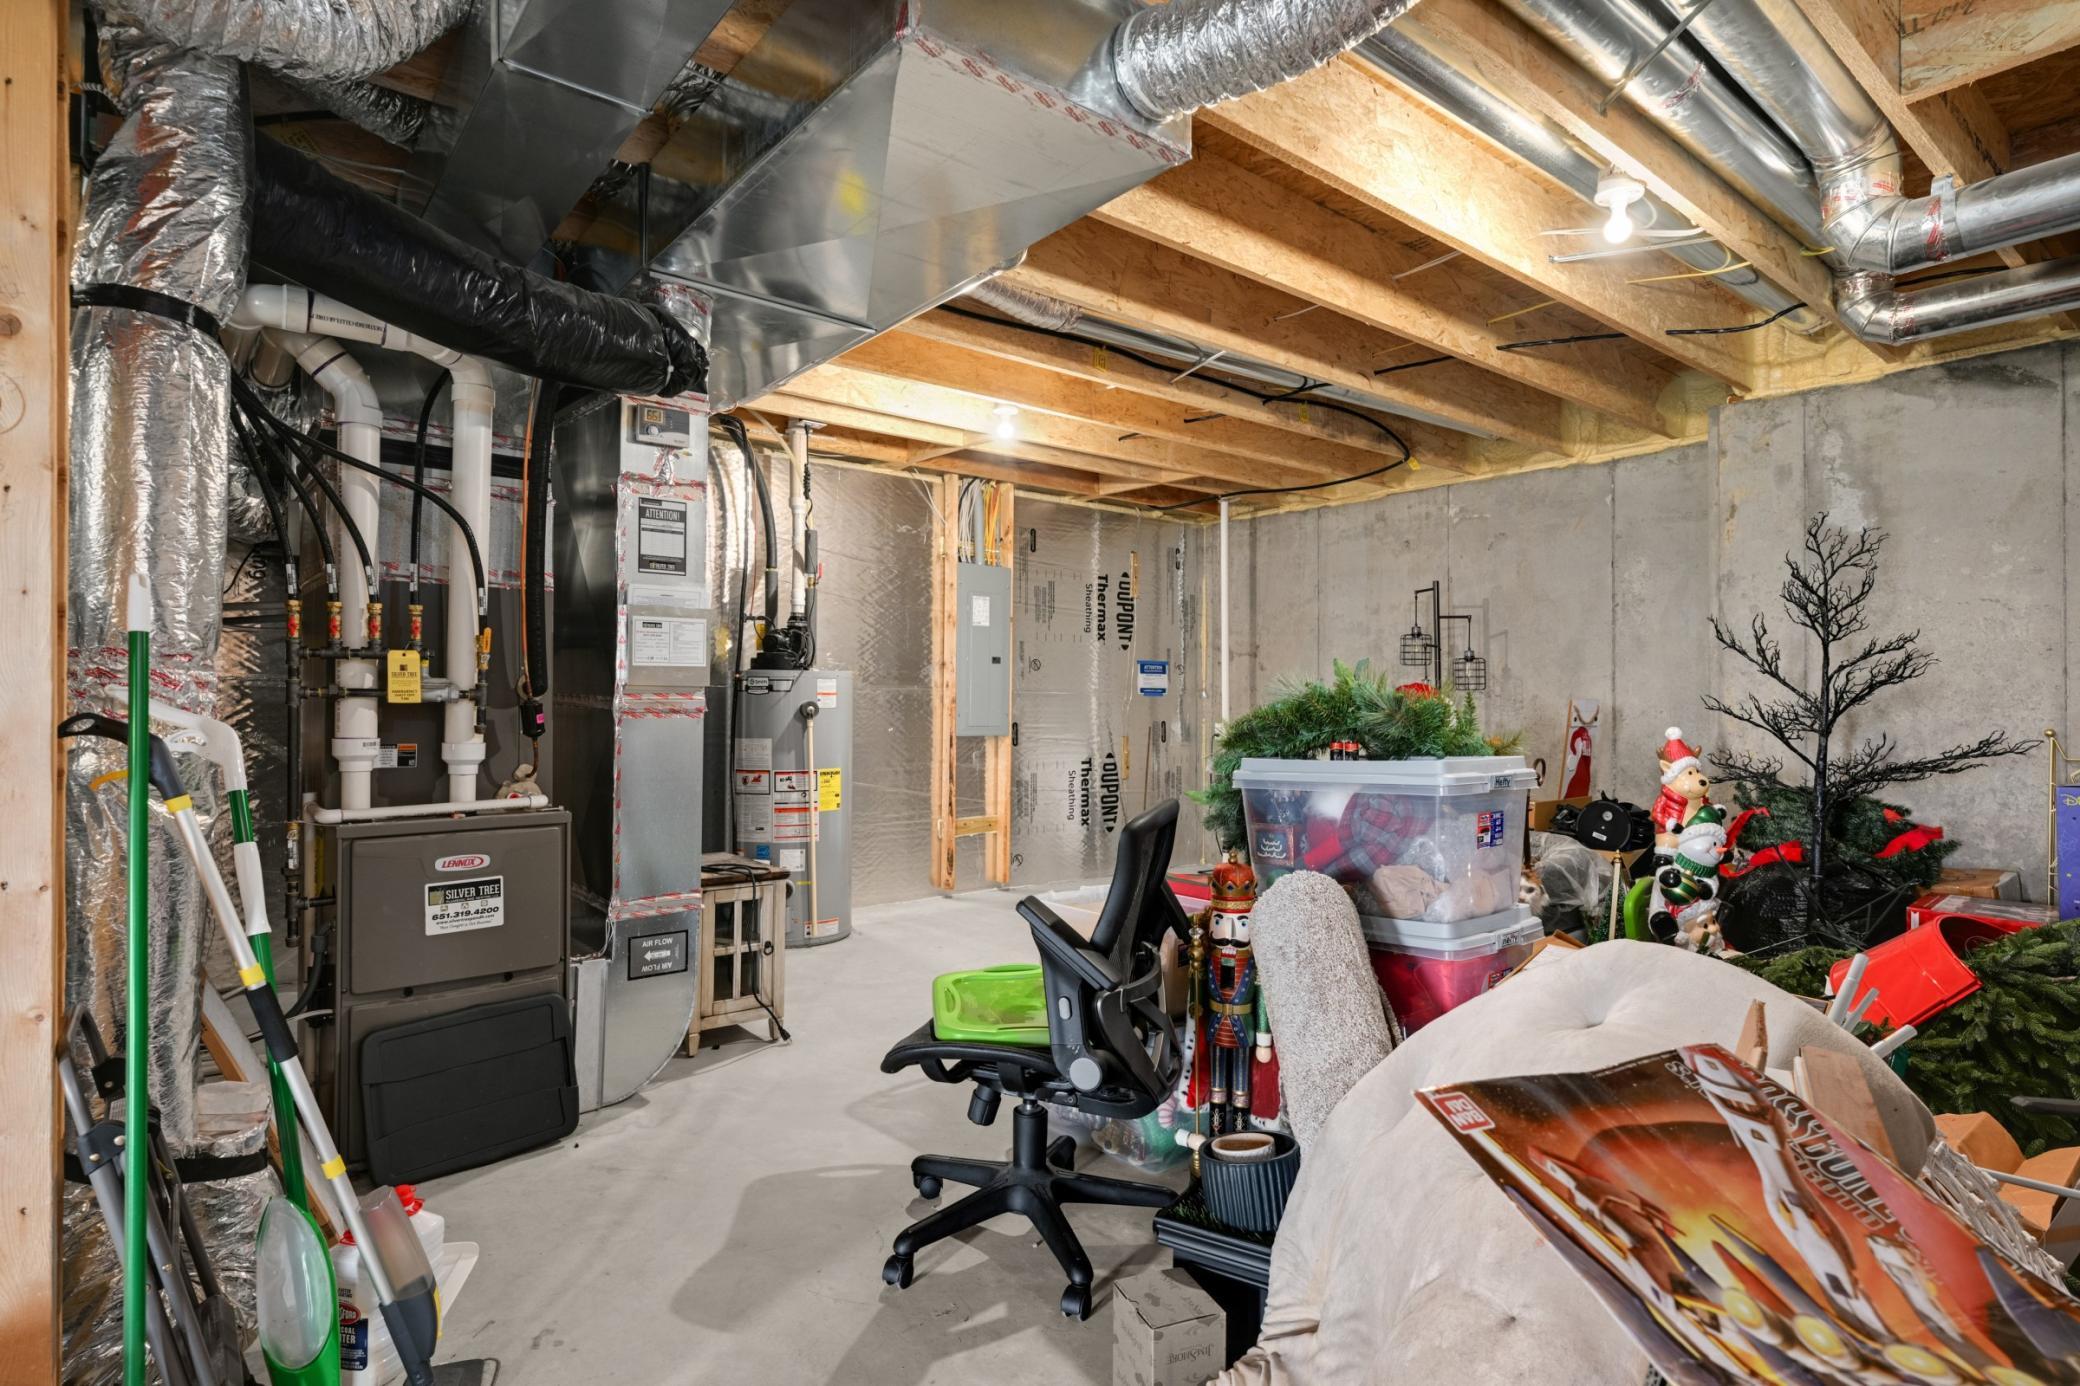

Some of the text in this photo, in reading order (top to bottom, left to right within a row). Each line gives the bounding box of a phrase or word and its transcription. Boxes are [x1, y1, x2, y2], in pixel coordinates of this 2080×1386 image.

[645, 508, 680, 521] ATTENTION!
[1084, 583, 1093, 633] Sheathing
[1097, 574, 1108, 641] Thermax
[1116, 580, 1135, 643] DUPONT
[1495, 777, 1511, 788] Hefty
[1067, 770, 1077, 821] Sheathing
[1081, 758, 1092, 826] Thermax
[1100, 762, 1119, 824] DUPONT
[441, 858, 476, 868] LENNOX
[445, 884, 500, 899] SILVER TREE
[431, 906, 500, 921] 651.319.4200
[642, 937, 673, 948] AIR FLOW
[641, 961, 673, 972] AIR FLOW
